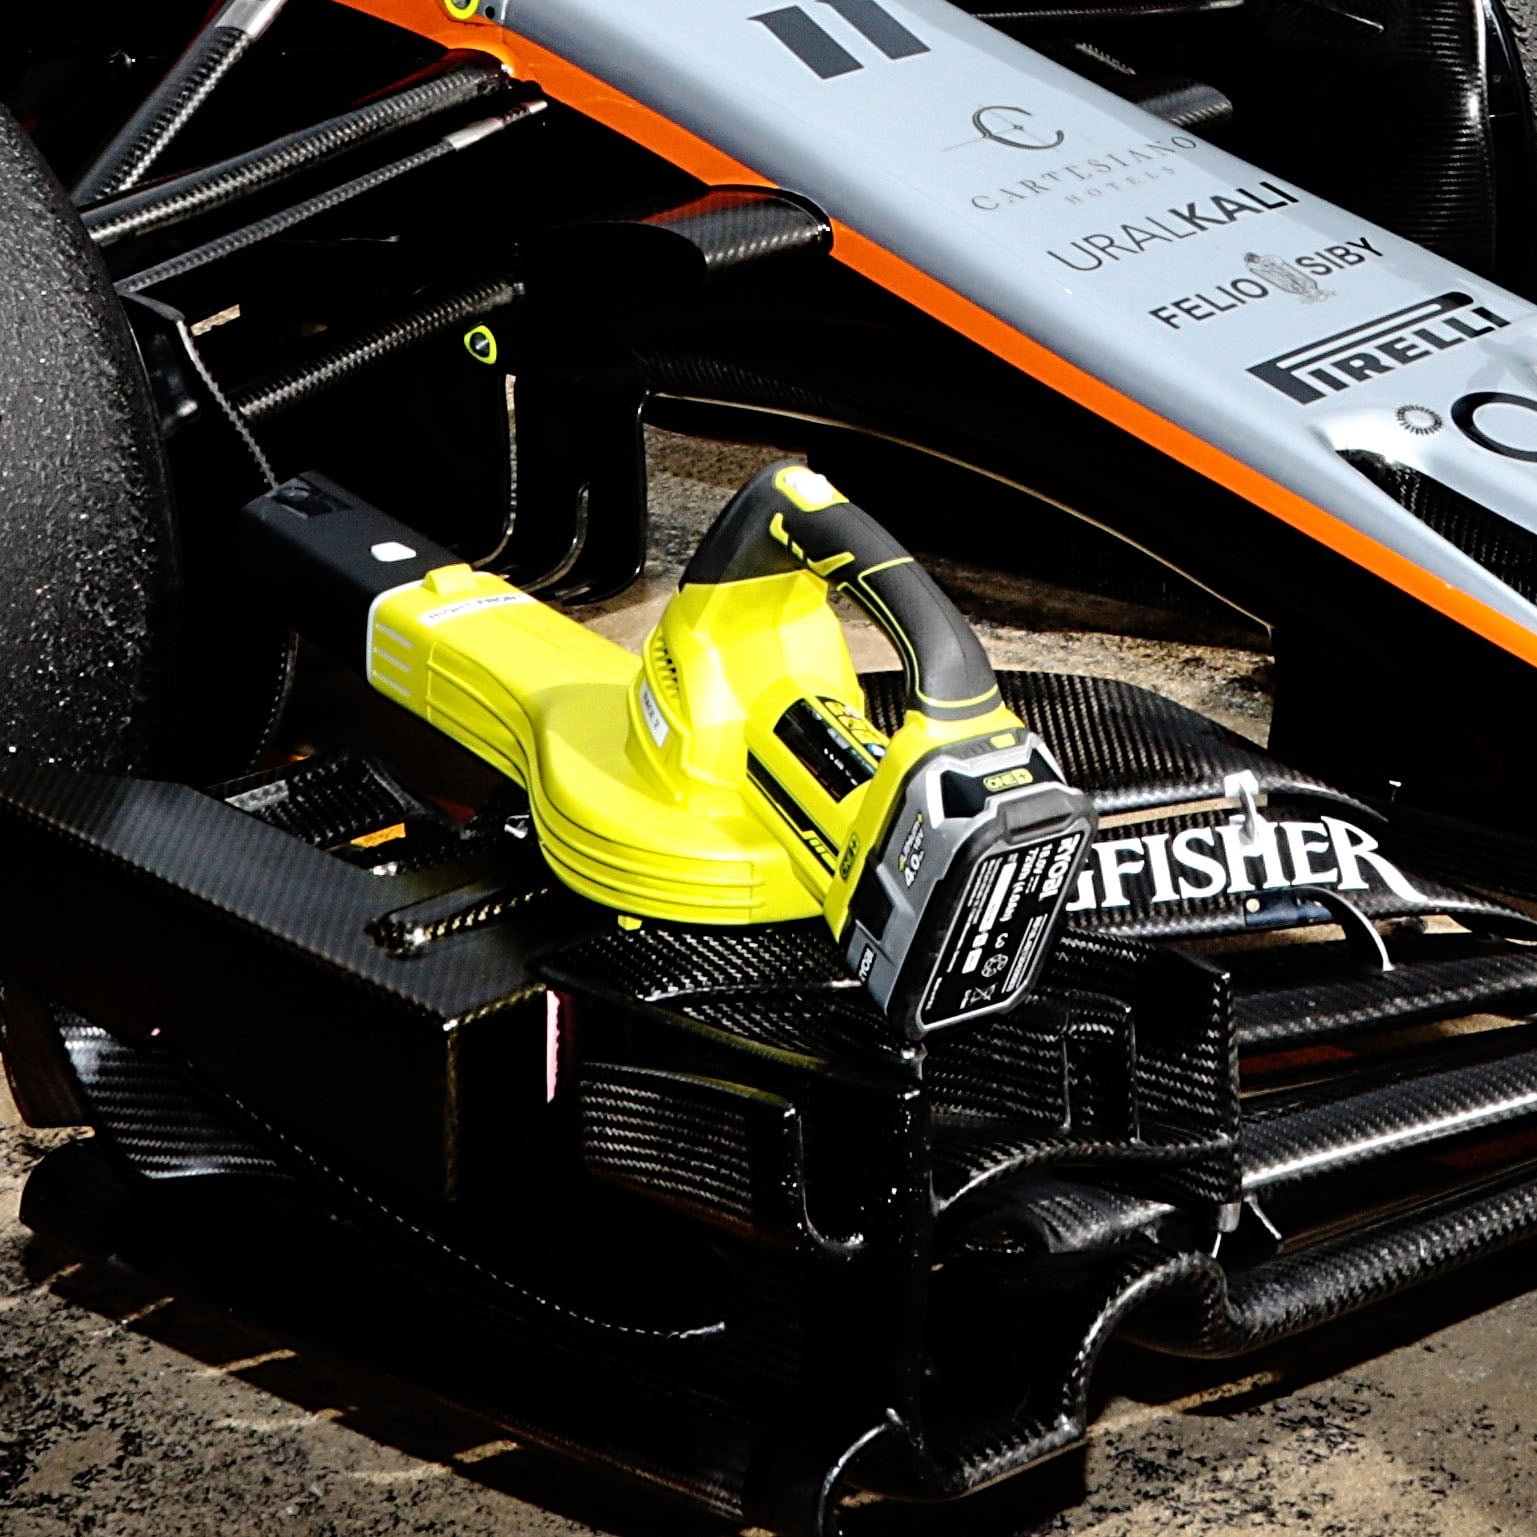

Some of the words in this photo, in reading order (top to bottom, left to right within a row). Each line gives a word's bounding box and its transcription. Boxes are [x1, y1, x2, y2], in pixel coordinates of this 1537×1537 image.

[969, 135, 1199, 214] CARTESIANO
[1065, 165, 1178, 207] HOTELS
[1046, 179, 1300, 274] URALKALI
[1149, 270, 1272, 331] FELIO
[1302, 236, 1385, 280] SIBY
[1246, 290, 1512, 405] PIRELLI
[1038, 833, 1081, 902] RYOBI
